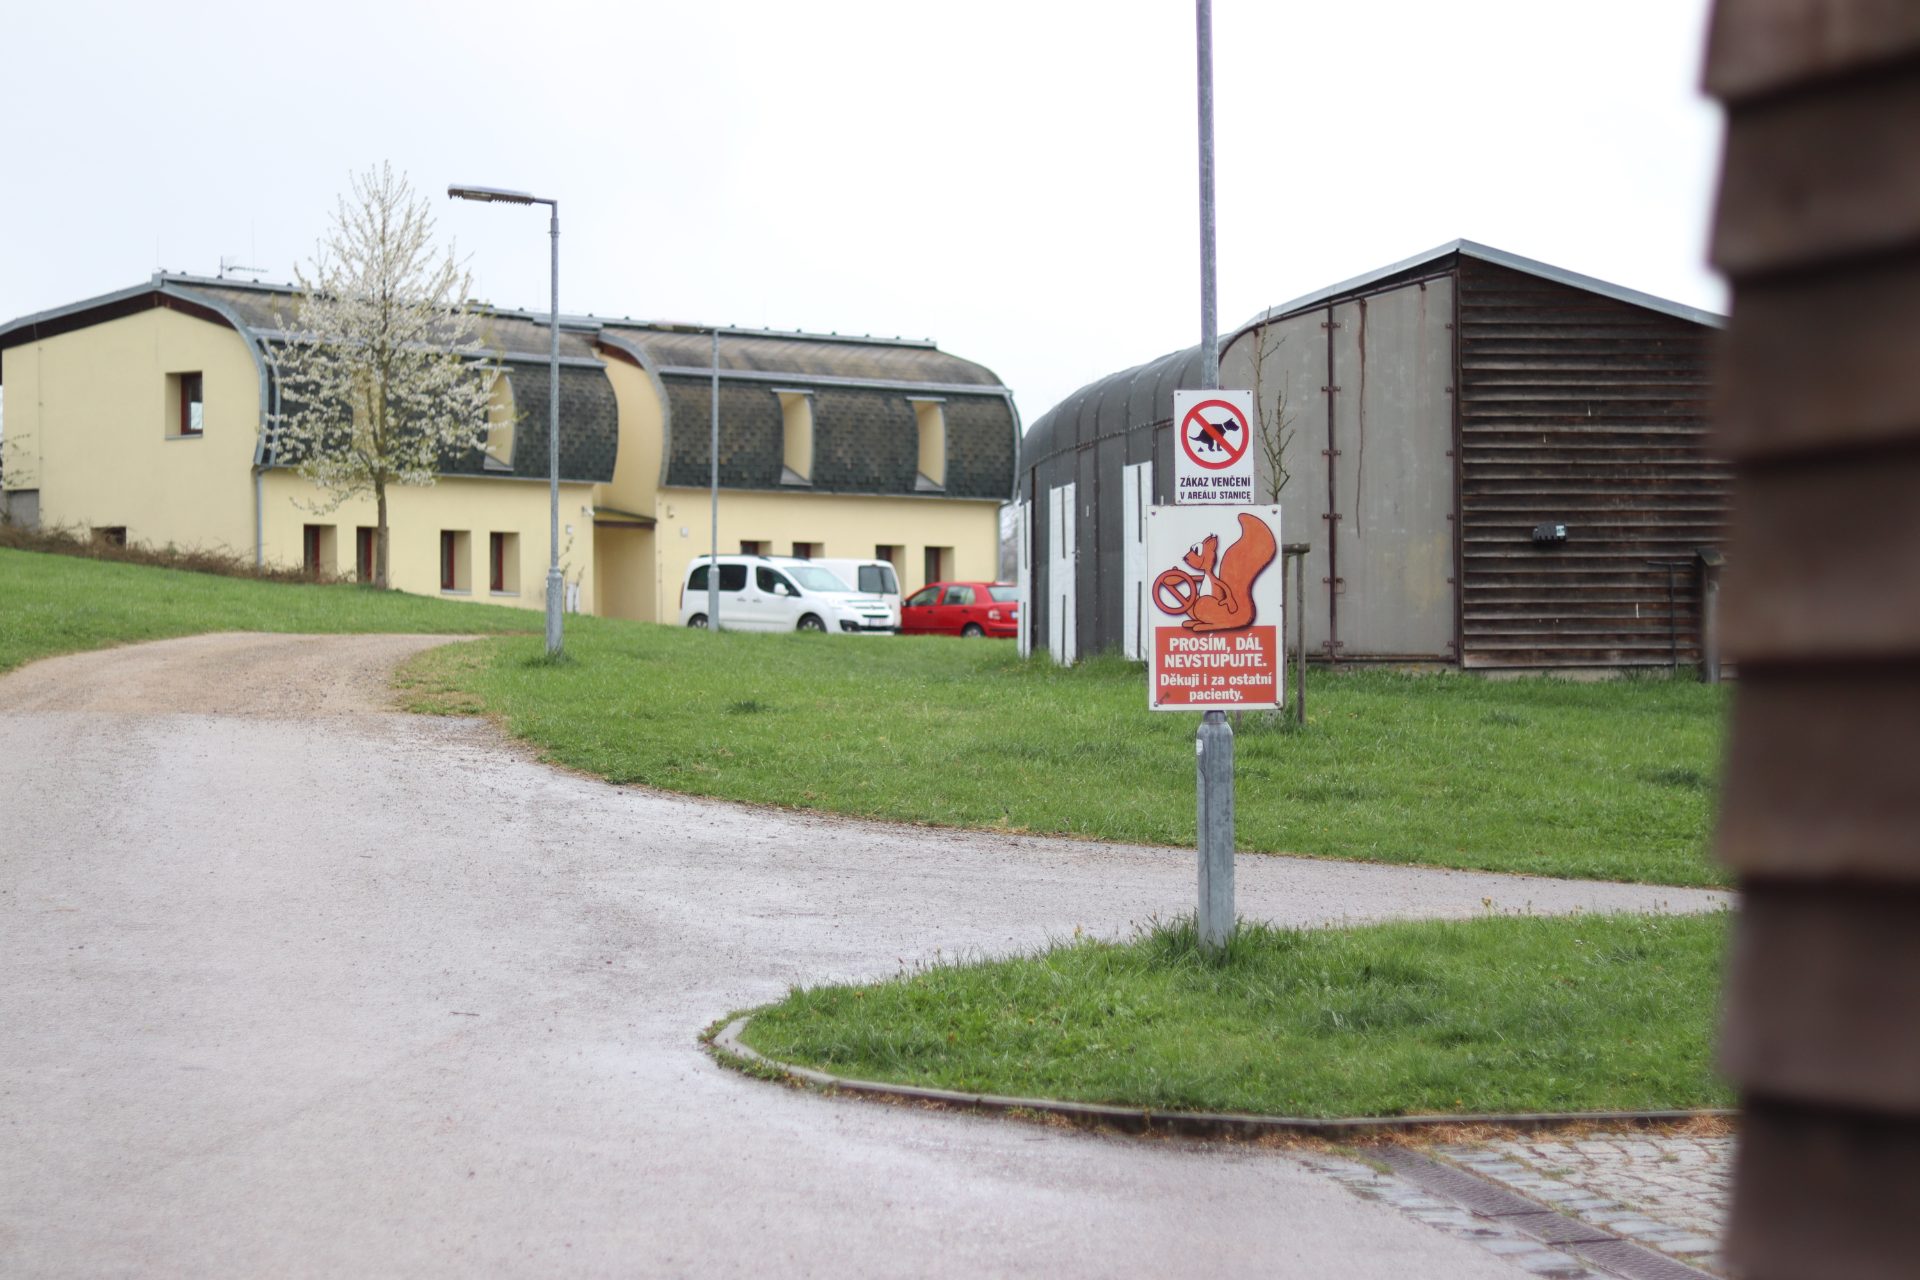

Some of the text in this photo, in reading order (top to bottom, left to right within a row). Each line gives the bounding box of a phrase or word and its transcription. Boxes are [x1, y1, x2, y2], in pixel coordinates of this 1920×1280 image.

[1180, 475, 1209, 487] ZÁKAZ
[1180, 490, 1251, 500] V AREÁLU STANICE
[1169, 632, 1263, 653] PROSÍM, DÁL
[1164, 653, 1267, 668] NEVSTUPUJTE.
[1160, 672, 1272, 687] Děkuji i za ostatní
[1190, 688, 1243, 702] pacienty.
